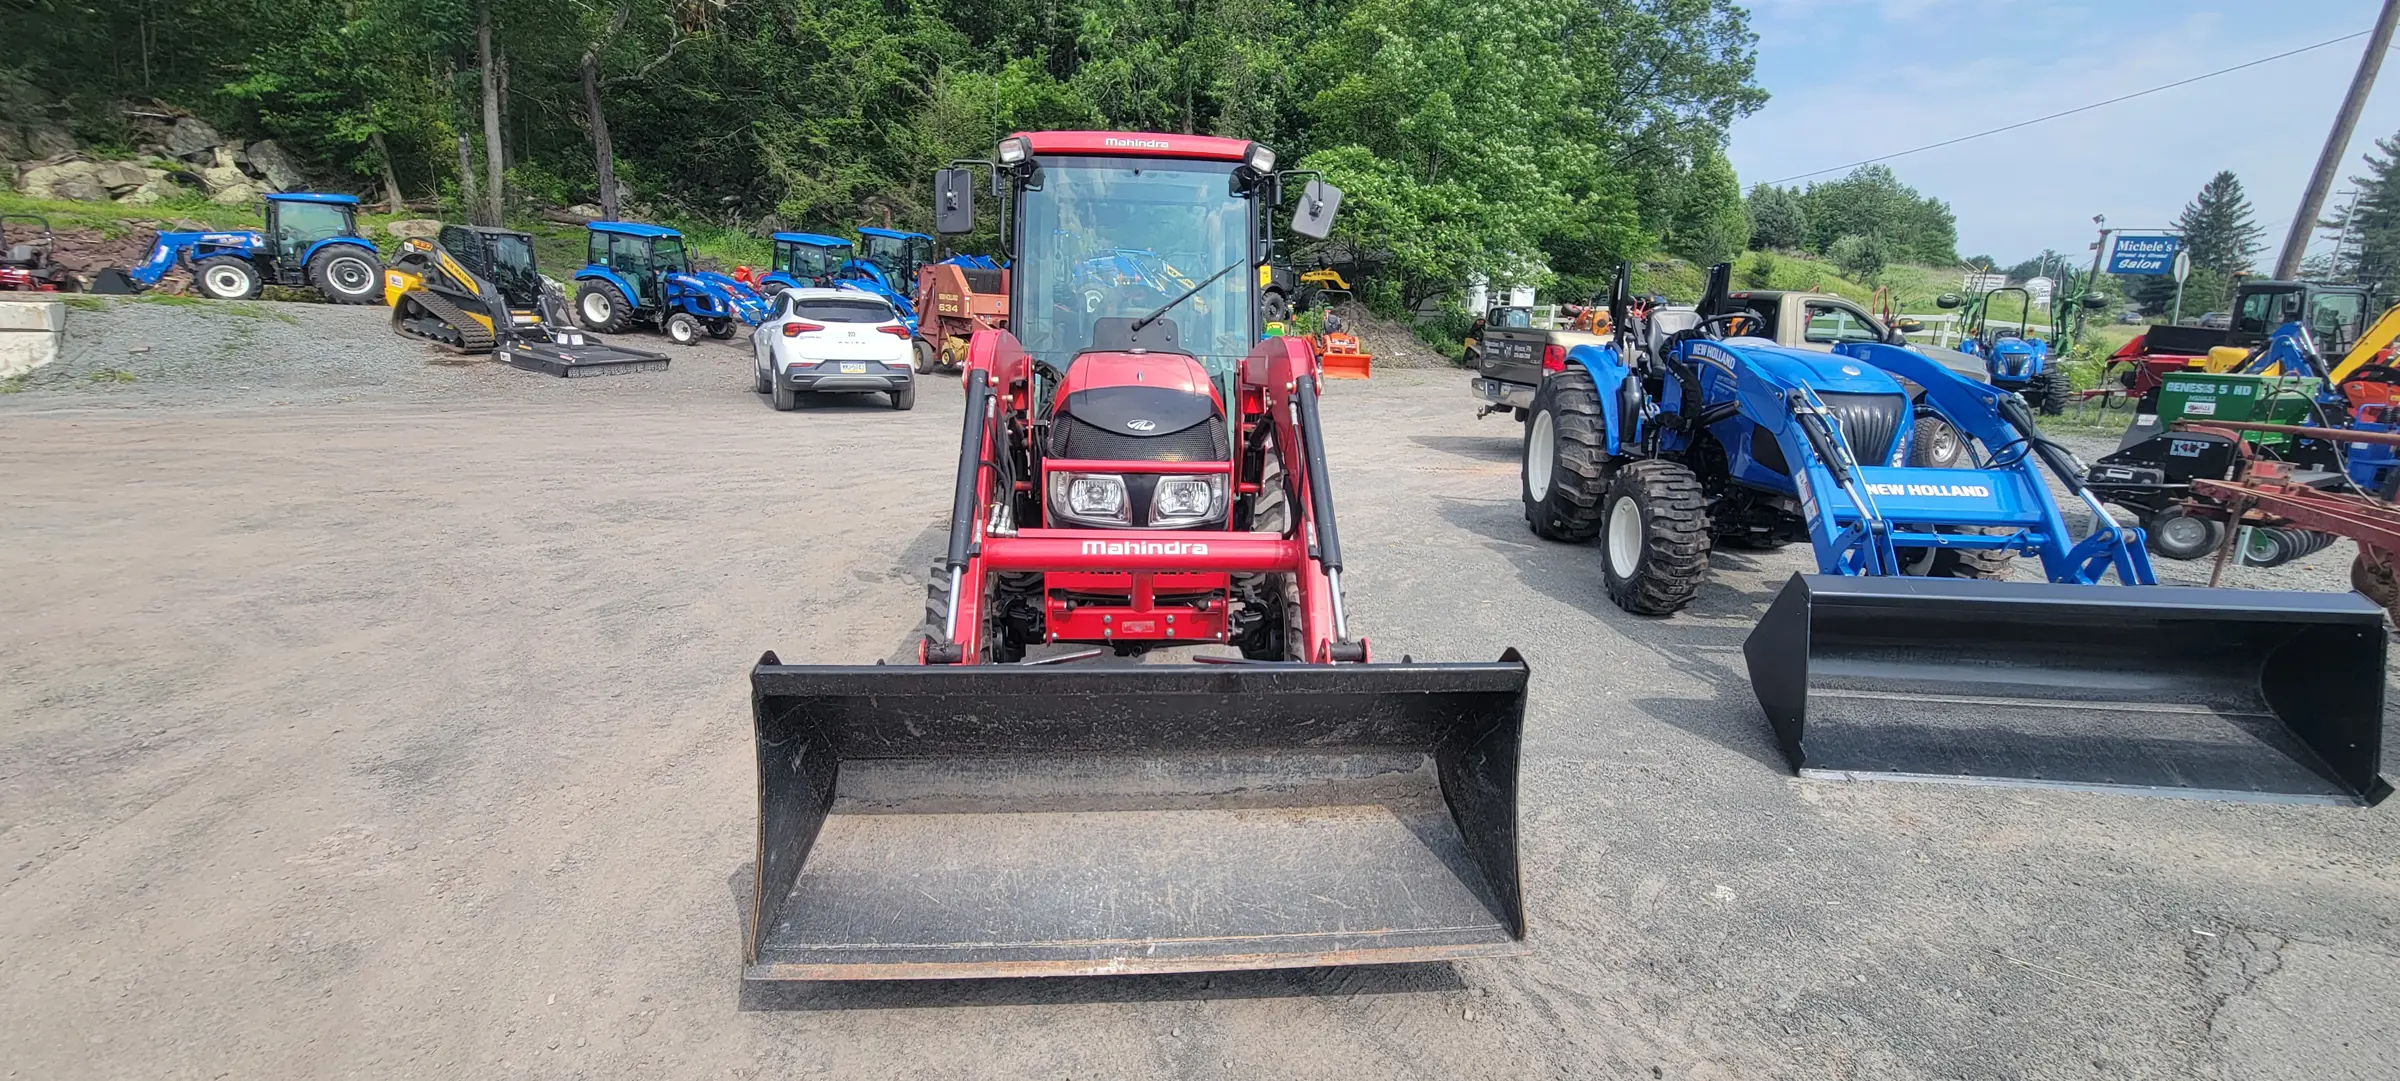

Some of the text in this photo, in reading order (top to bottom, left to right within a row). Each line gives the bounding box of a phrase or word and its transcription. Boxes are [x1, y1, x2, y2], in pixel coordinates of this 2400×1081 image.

[1105, 138, 1169, 148] Mahindra
[2117, 240, 2172, 252] Michele's
[2118, 258, 2162, 269] Salon
[938, 303, 959, 313] 634
[1692, 343, 1736, 370] NEW HOLLAND
[2166, 382, 2252, 396] GENESIS 5 HD
[1866, 483, 1989, 498] NEW HOLLAND
[1081, 540, 1209, 555] Mahindra
